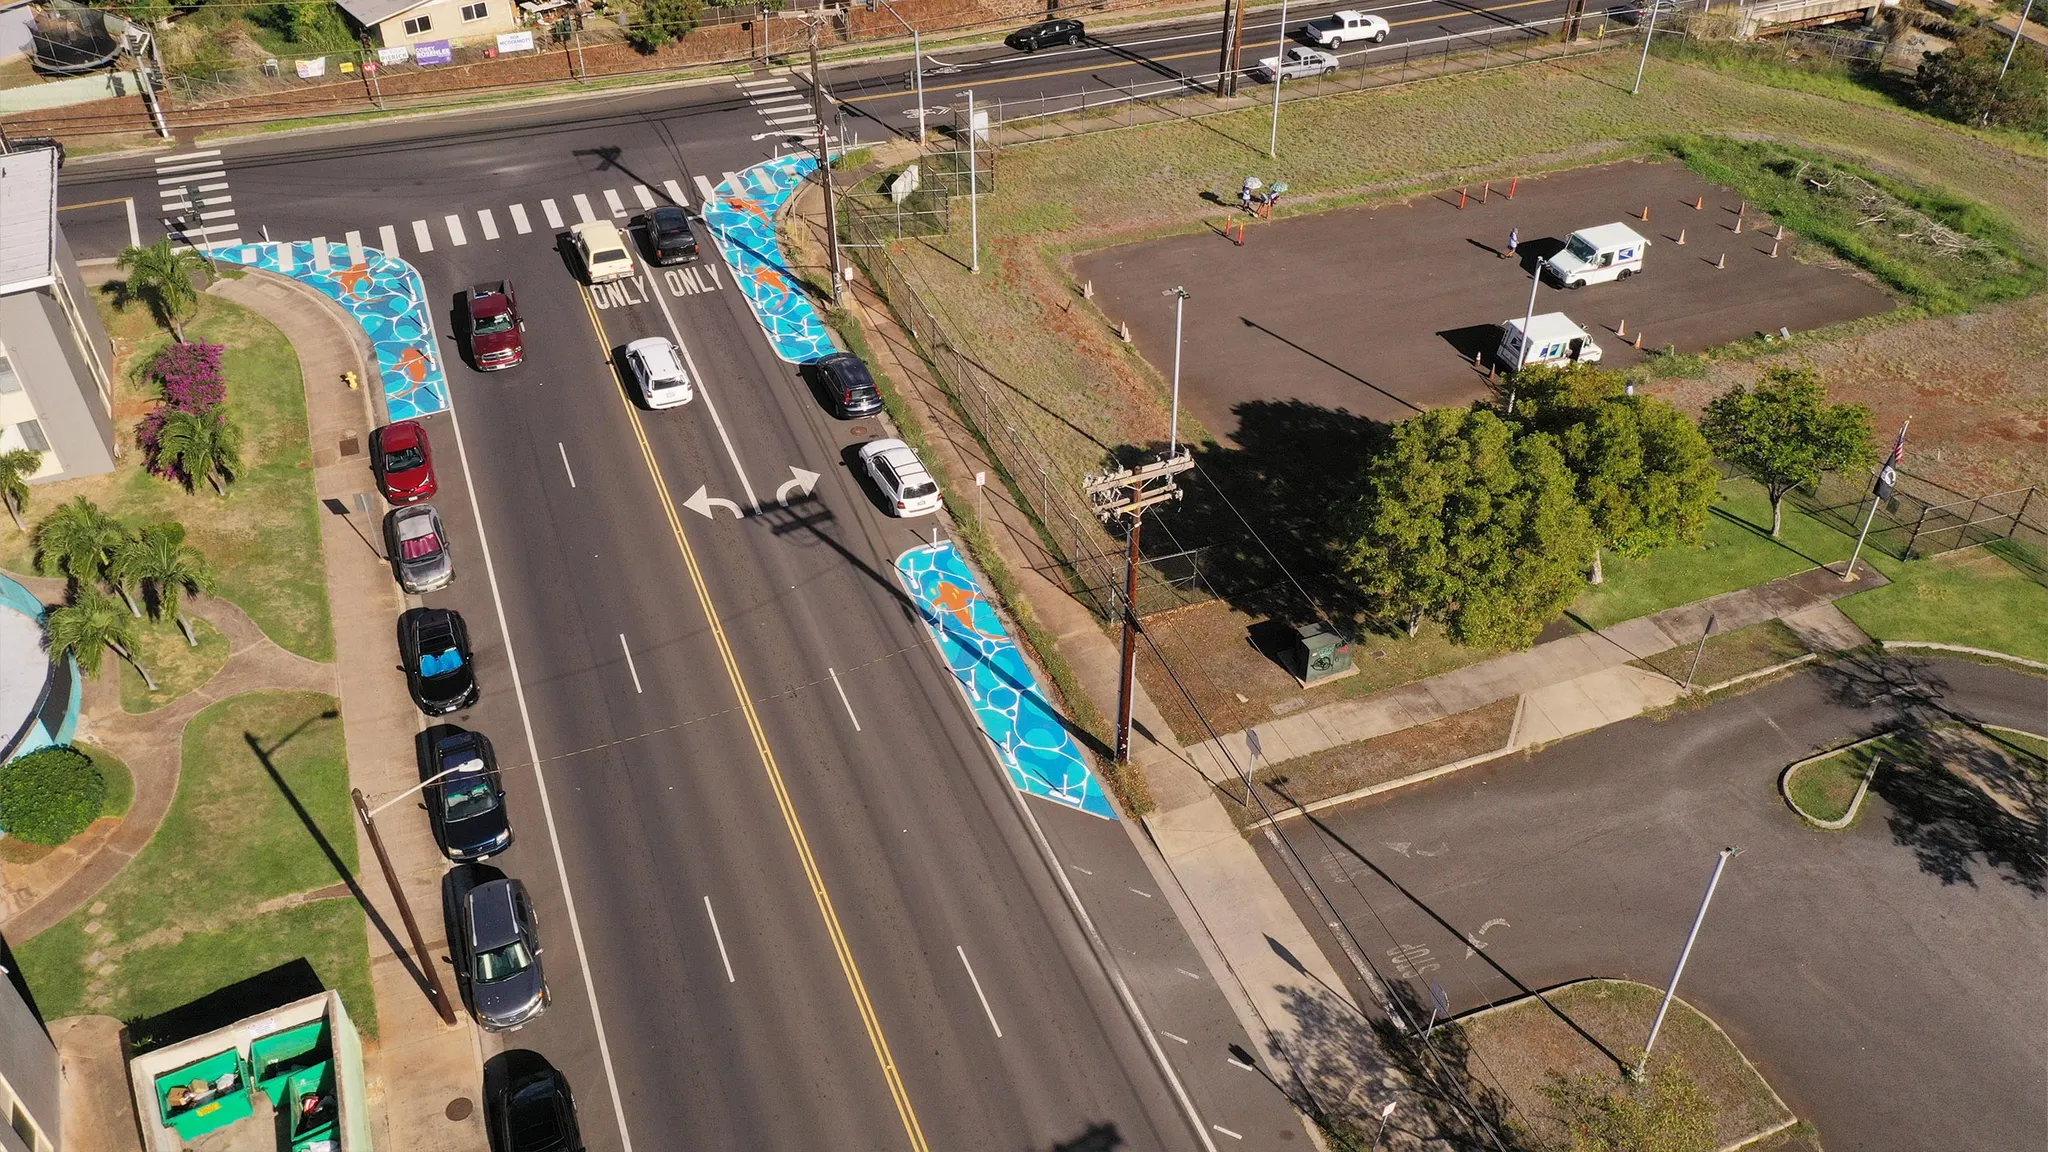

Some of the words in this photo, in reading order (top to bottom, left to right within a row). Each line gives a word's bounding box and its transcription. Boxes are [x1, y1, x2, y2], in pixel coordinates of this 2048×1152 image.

[380, 52, 407, 61] PIERICK
[590, 275, 650, 310] ONLY
[664, 263, 724, 297] ONLY
